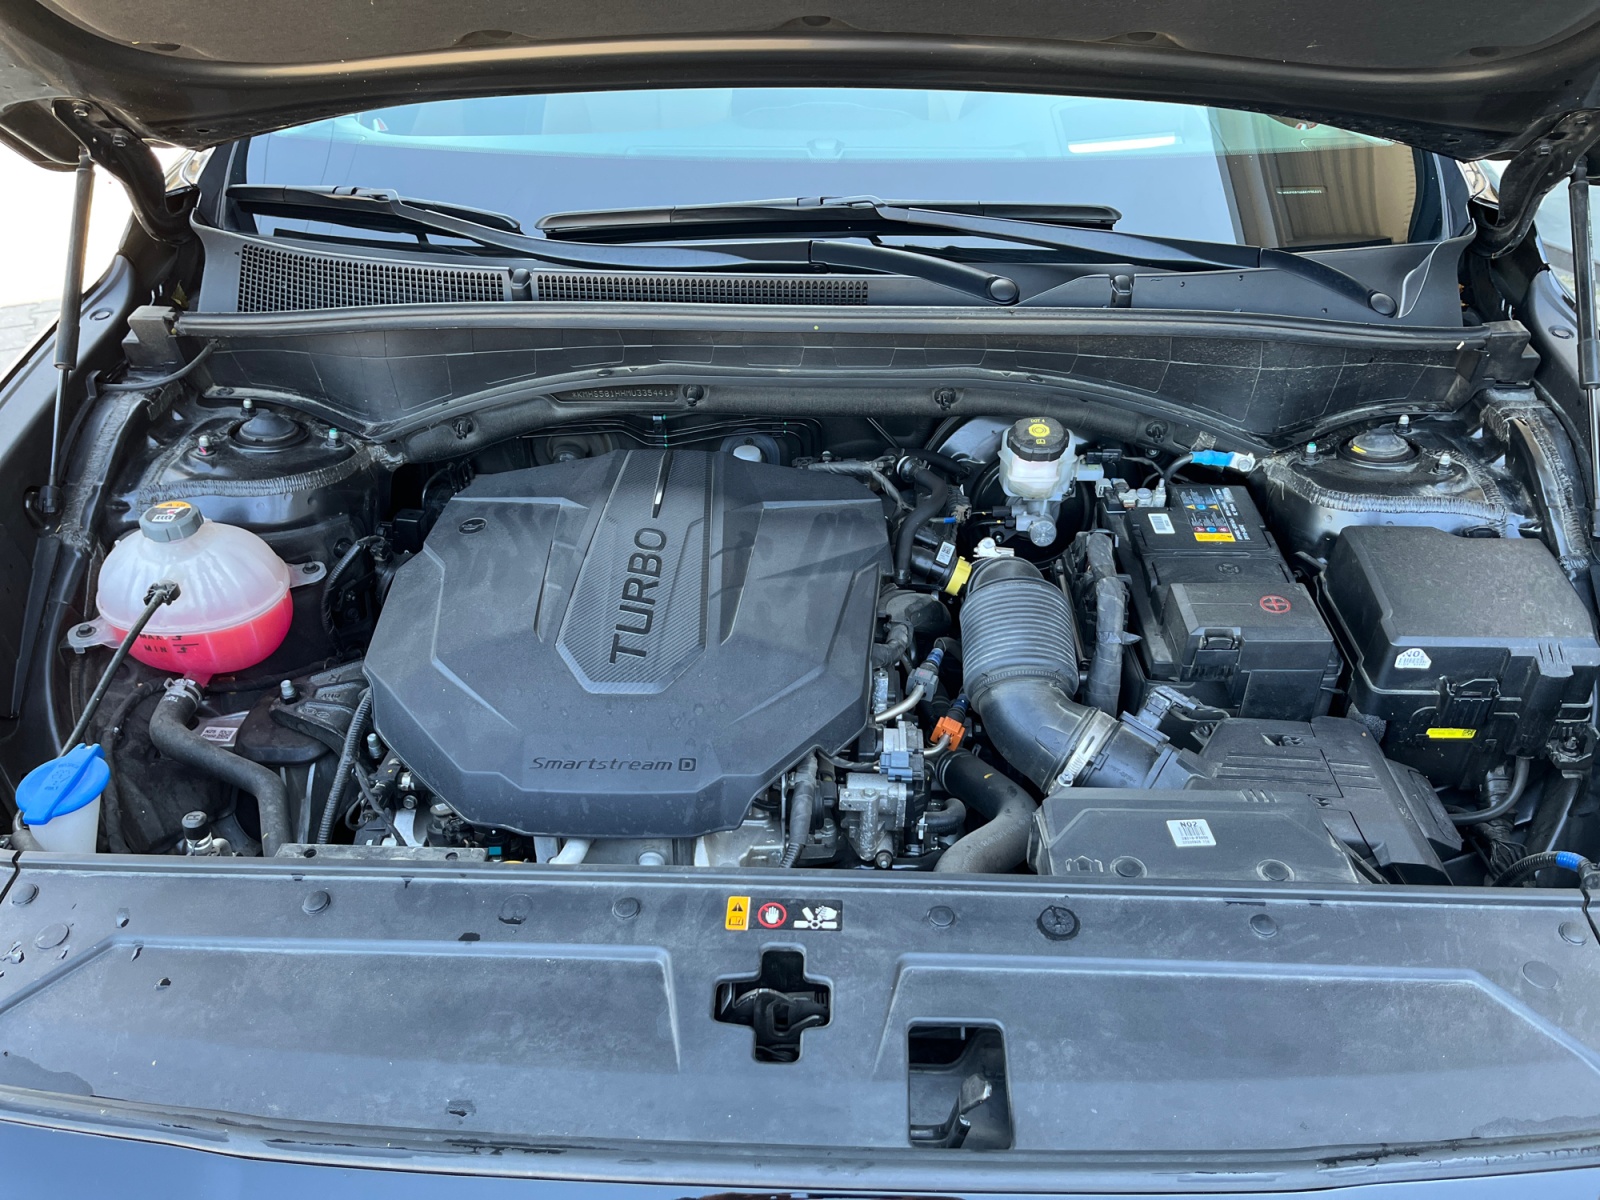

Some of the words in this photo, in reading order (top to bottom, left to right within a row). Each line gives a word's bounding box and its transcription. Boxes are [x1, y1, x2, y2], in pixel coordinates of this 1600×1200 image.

[609, 527, 668, 665] TURBO
[143, 644, 168, 653] MIN
[529, 756, 674, 772] Smartstream
[678, 757, 698, 772] D
